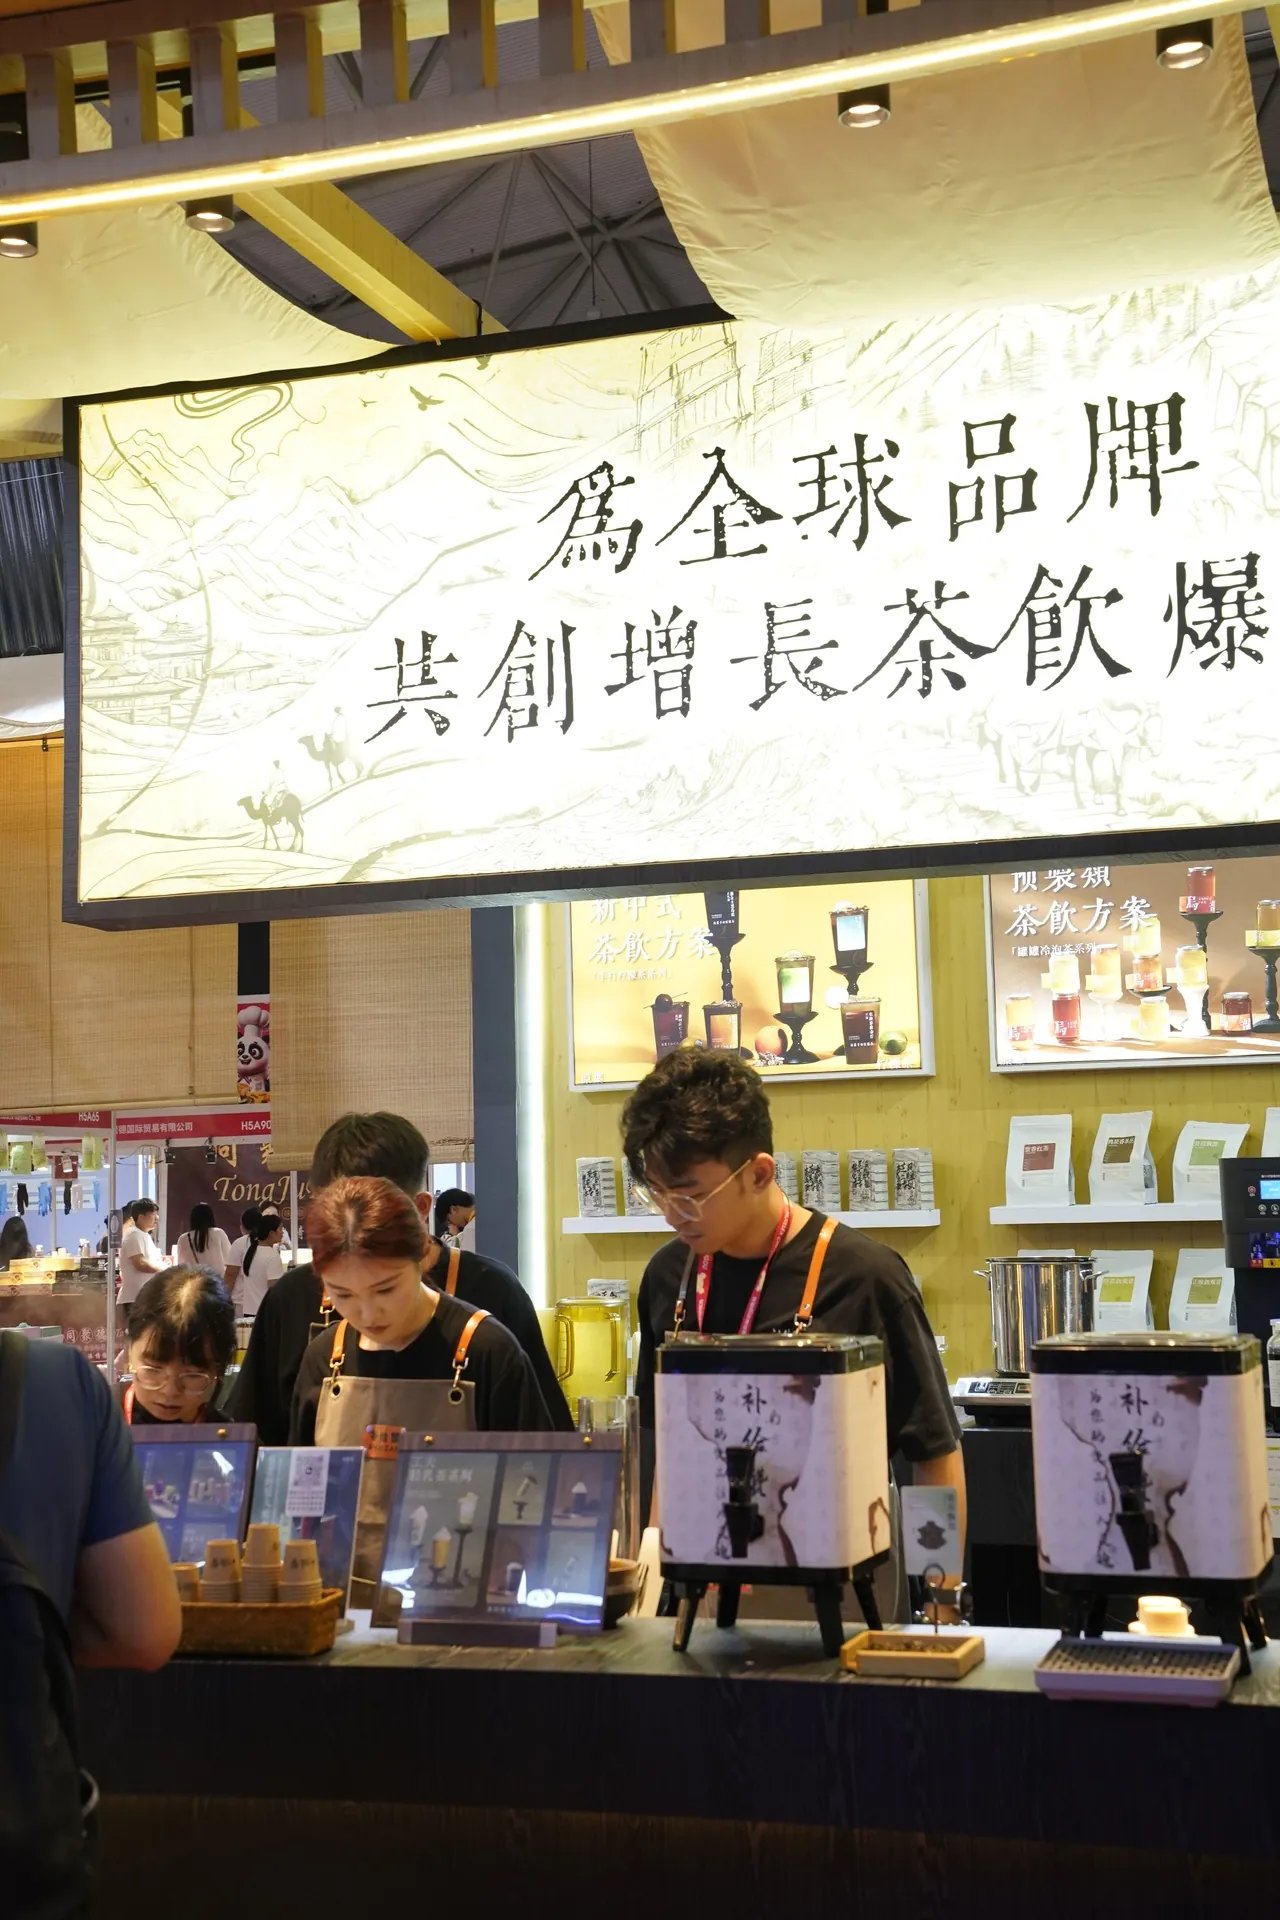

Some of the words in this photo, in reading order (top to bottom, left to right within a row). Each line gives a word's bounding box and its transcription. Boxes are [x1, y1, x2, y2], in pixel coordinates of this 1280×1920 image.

[529, 391, 1200, 580] 為全球品牌
[364, 551, 1271, 743] 共創增長茶飲爆
[589, 926, 717, 964] 茶飲方案
[1004, 896, 1158, 936] 茶飲方案
